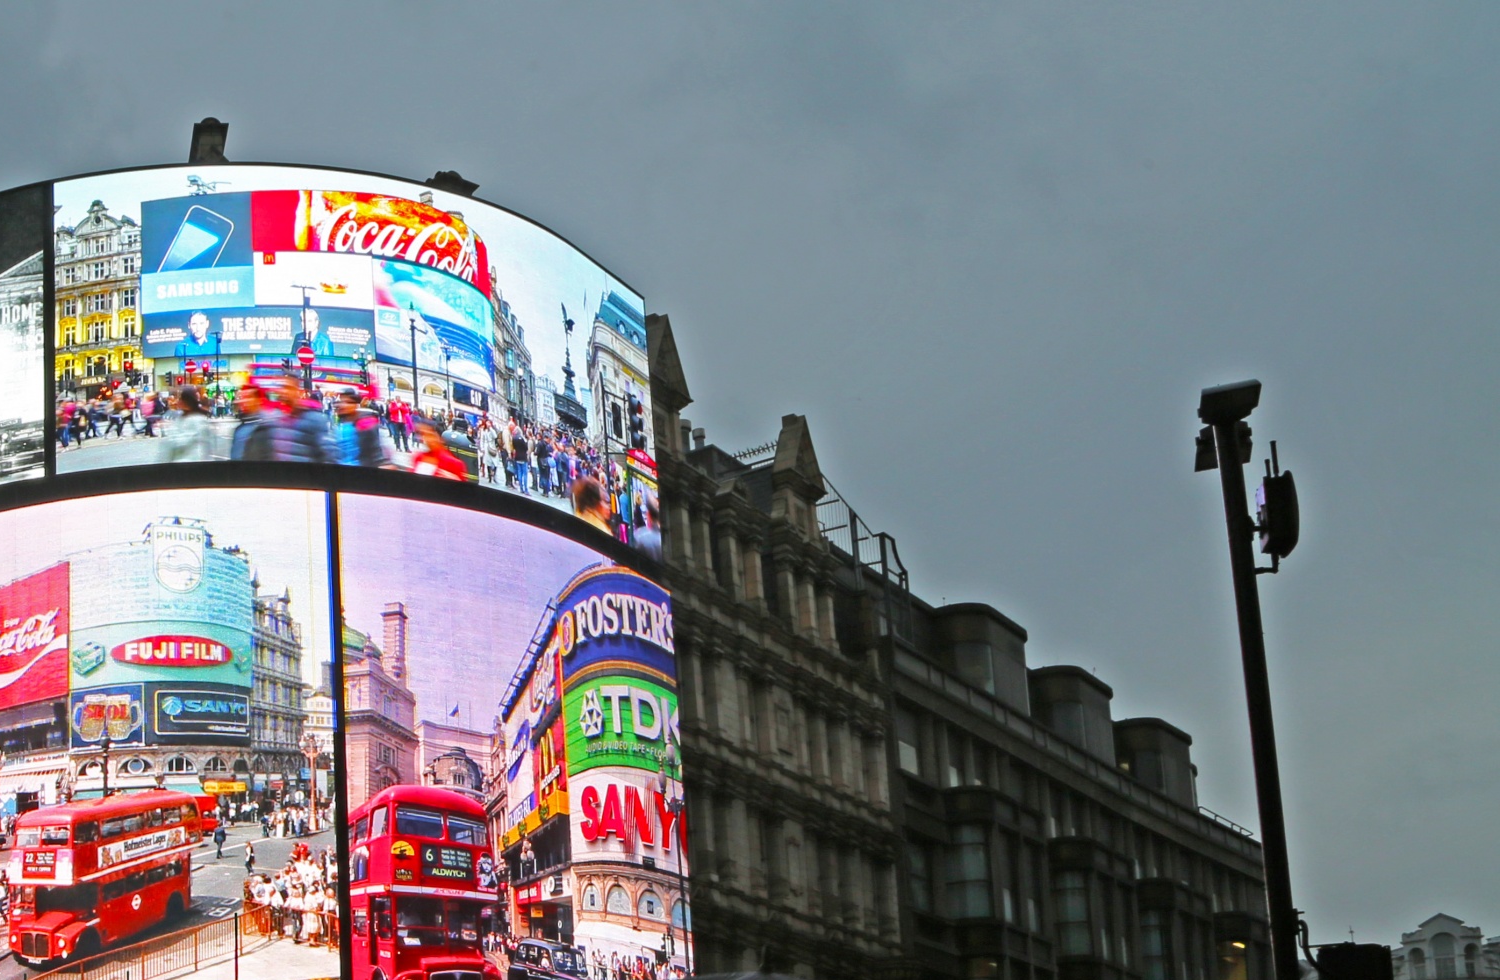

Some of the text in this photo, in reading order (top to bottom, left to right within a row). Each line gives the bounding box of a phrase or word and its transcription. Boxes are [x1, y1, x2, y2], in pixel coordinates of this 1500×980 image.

[319, 203, 474, 282] Coca-Cola
[157, 279, 240, 300] SAMSUNG
[221, 316, 291, 332] THE SPANISH
[156, 531, 201, 543] PHILIPS
[600, 684, 681, 746] TDK
[608, 741, 628, 752] VIDEO
[629, 741, 646, 753] TAPE
[123, 836, 152, 852] Hofmeister
[152, 833, 167, 847] Lager
[25, 852, 34, 863] 22
[425, 848, 434, 862] 6
[431, 867, 467, 878] ALDWYCH
